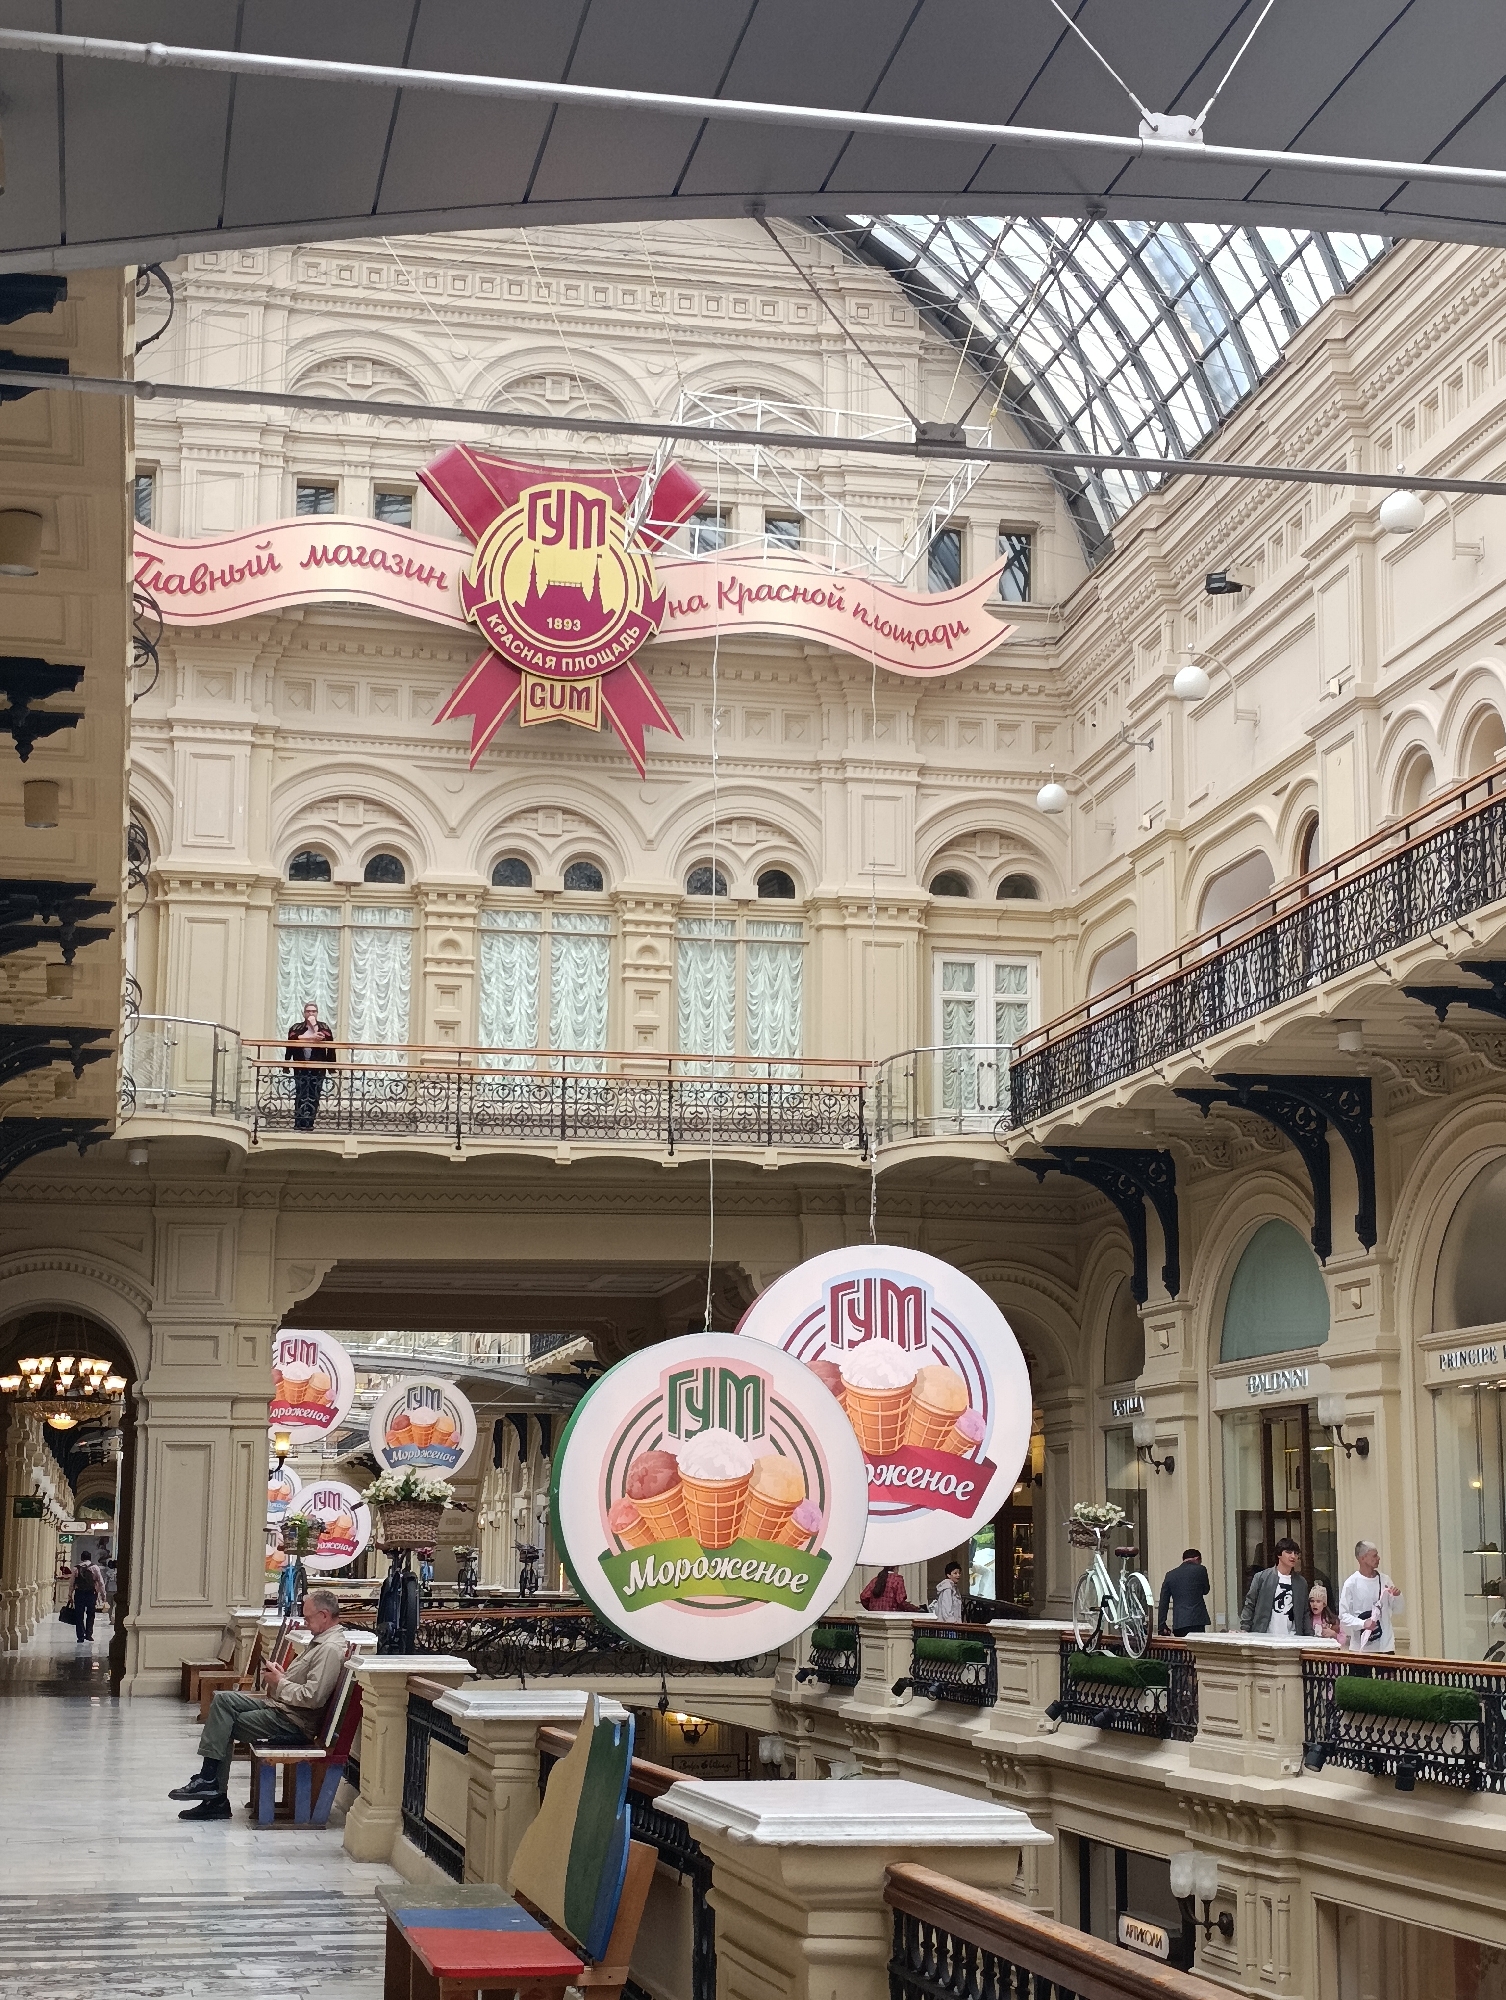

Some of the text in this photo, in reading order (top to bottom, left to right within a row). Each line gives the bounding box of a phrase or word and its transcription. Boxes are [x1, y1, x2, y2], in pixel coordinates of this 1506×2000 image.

[528, 489, 606, 551] ГУМ
[134, 541, 449, 595] Главный магазин
[546, 617, 581, 632] 1893
[668, 576, 970, 652] на Красной площади
[487, 613, 640, 672] КРАСНАЯ ПЛОЩАДЬ
[530, 682, 593, 712] GUM
[829, 1277, 928, 1352] ГУМ
[280, 1339, 319, 1367] ГУМ
[1439, 1346, 1498, 1370] PRINCIPE
[406, 1385, 443, 1412] ГУМ
[667, 1366, 765, 1443] ГУМ
[390, 1449, 456, 1464] Мороженое
[865, 1463, 975, 1501] оженое
[622, 1554, 810, 1597] Мороженое
